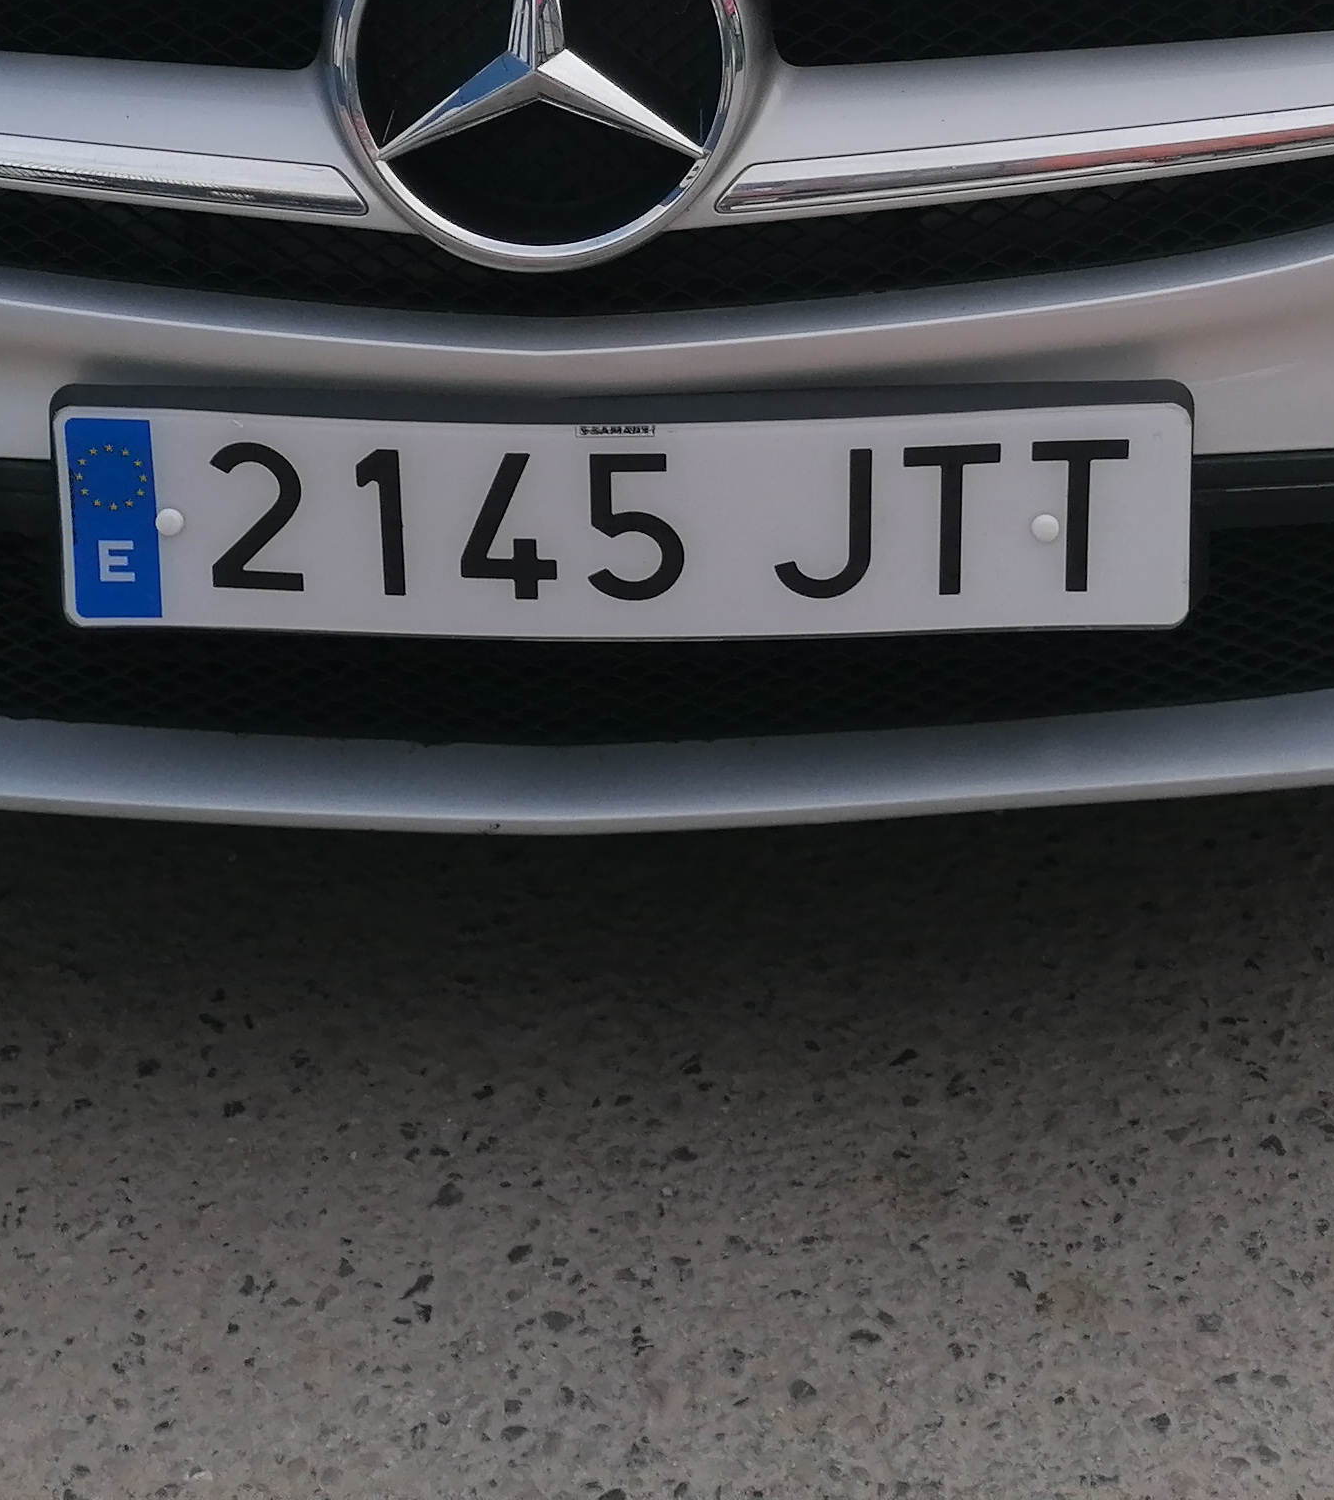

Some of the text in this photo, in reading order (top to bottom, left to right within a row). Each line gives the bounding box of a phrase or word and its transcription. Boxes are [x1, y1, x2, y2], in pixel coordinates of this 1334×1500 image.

[98, 540, 136, 582] E
[209, 442, 685, 600] 2145
[774, 439, 1130, 599] JTT
